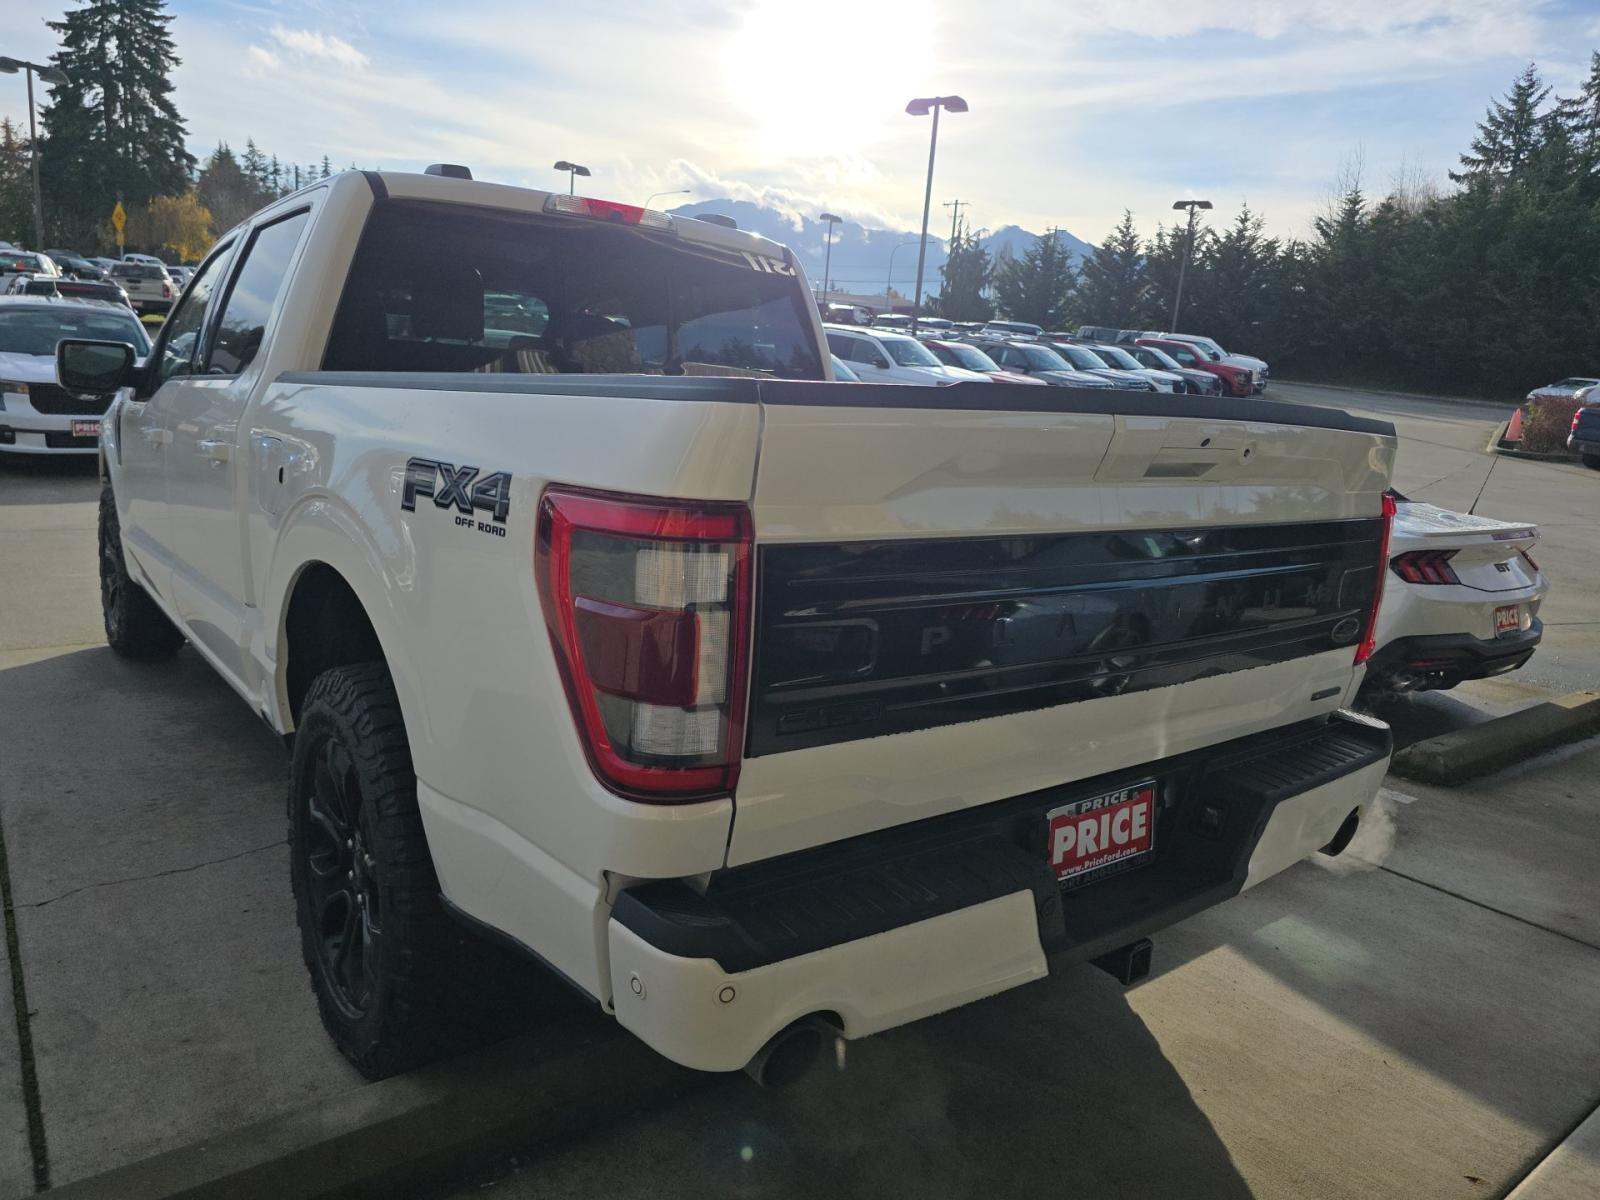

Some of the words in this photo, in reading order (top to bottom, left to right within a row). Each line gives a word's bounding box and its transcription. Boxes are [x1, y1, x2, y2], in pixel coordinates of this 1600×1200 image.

[401, 456, 513, 525] FX4
[454, 515, 475, 529] OFF
[478, 521, 507, 538] ROAD
[1494, 563, 1510, 572] GT
[1497, 608, 1518, 626] PRICE
[1082, 792, 1129, 813] PRICE
[1052, 803, 1148, 865] PRICE
[1060, 846, 1138, 877] www.PriceFord.com
